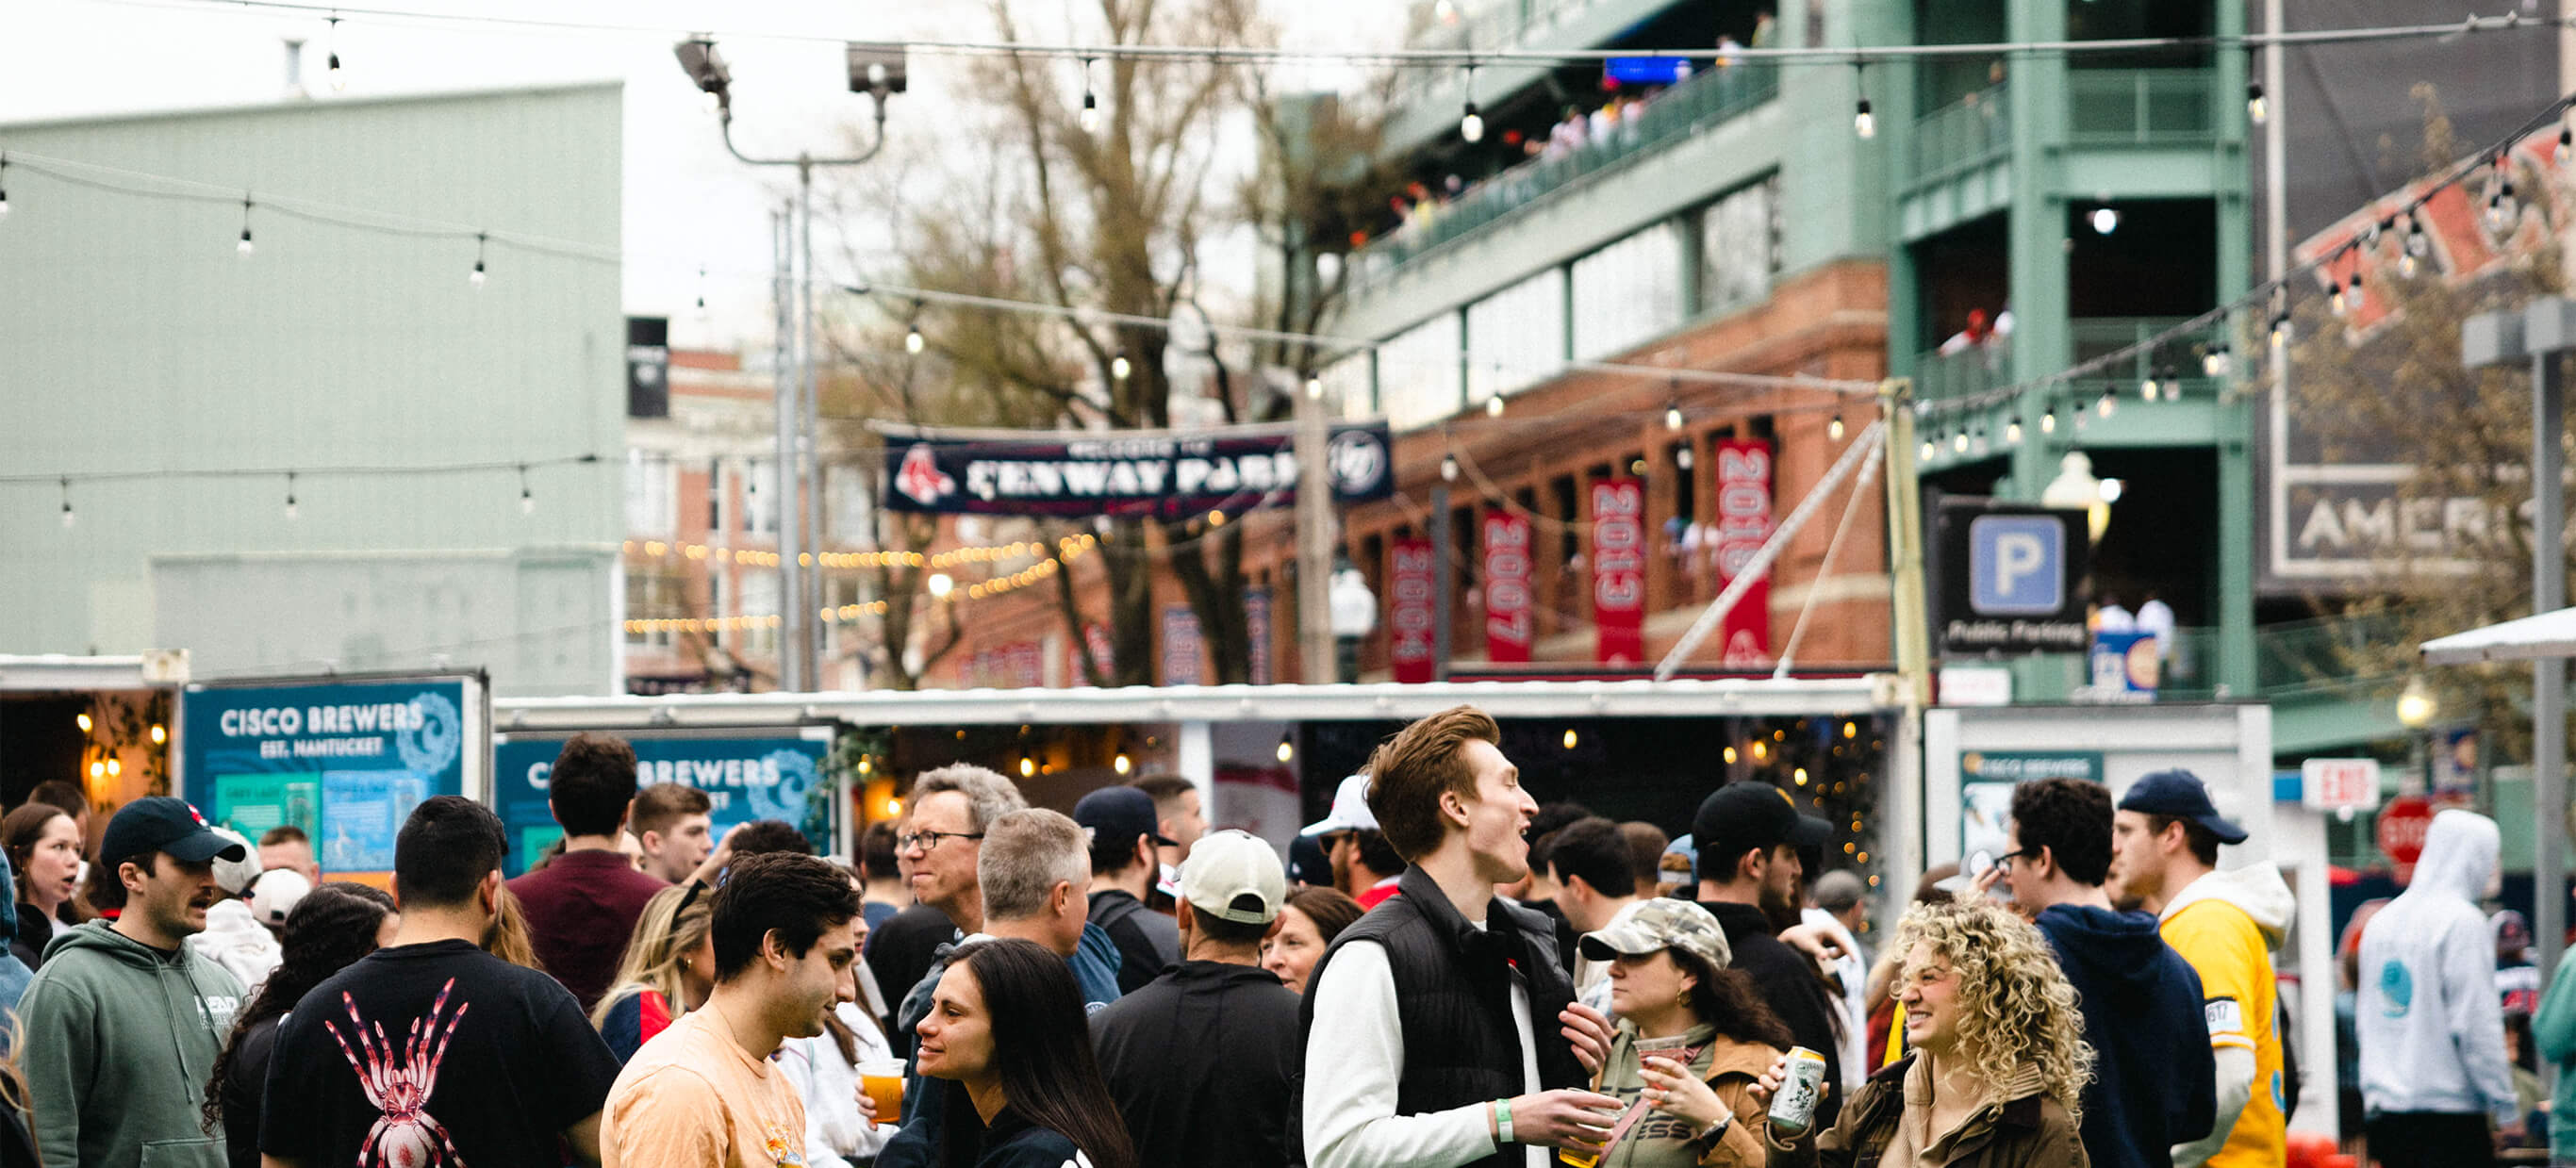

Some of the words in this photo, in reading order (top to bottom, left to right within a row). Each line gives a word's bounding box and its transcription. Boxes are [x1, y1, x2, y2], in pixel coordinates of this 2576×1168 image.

[966, 459, 1169, 498] FENWAY
[1591, 483, 1644, 611] 2013
[1995, 533, 2044, 597] P
[1484, 520, 1530, 643] 2007
[1390, 547, 1435, 660] 2004
[1948, 619, 2008, 642] Public
[2010, 619, 2085, 646] Parking
[220, 707, 303, 737] CISCO
[307, 701, 424, 734] BREWERS
[260, 740, 289, 759] EST.
[293, 736, 385, 757] NANTUCKET
[636, 757, 782, 790] BREWERS
